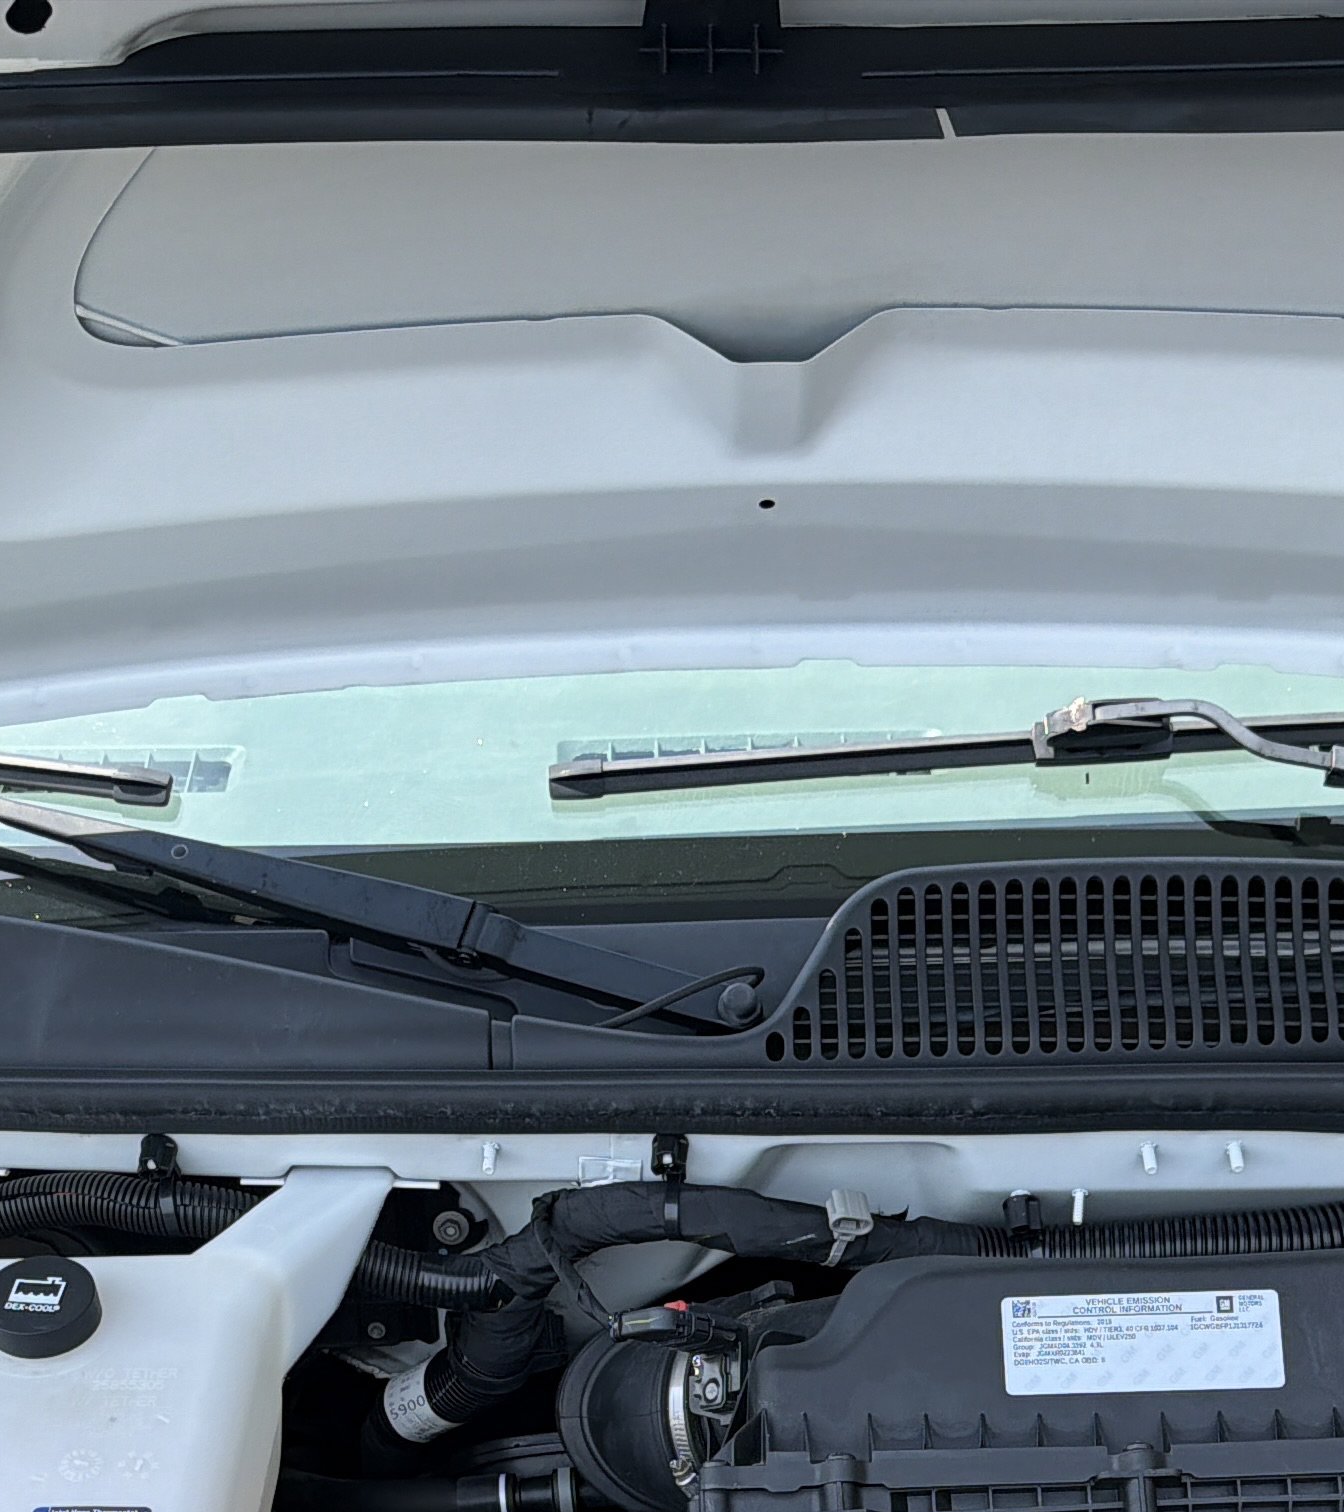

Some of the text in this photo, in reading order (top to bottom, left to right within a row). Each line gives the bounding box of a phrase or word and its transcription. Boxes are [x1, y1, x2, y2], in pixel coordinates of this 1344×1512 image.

[1085, 1296, 1171, 1306] VEHICLE EMISSION
[1072, 1304, 1182, 1315] CONTROL INFORMATION
[389, 1393, 426, 1420] 5900
